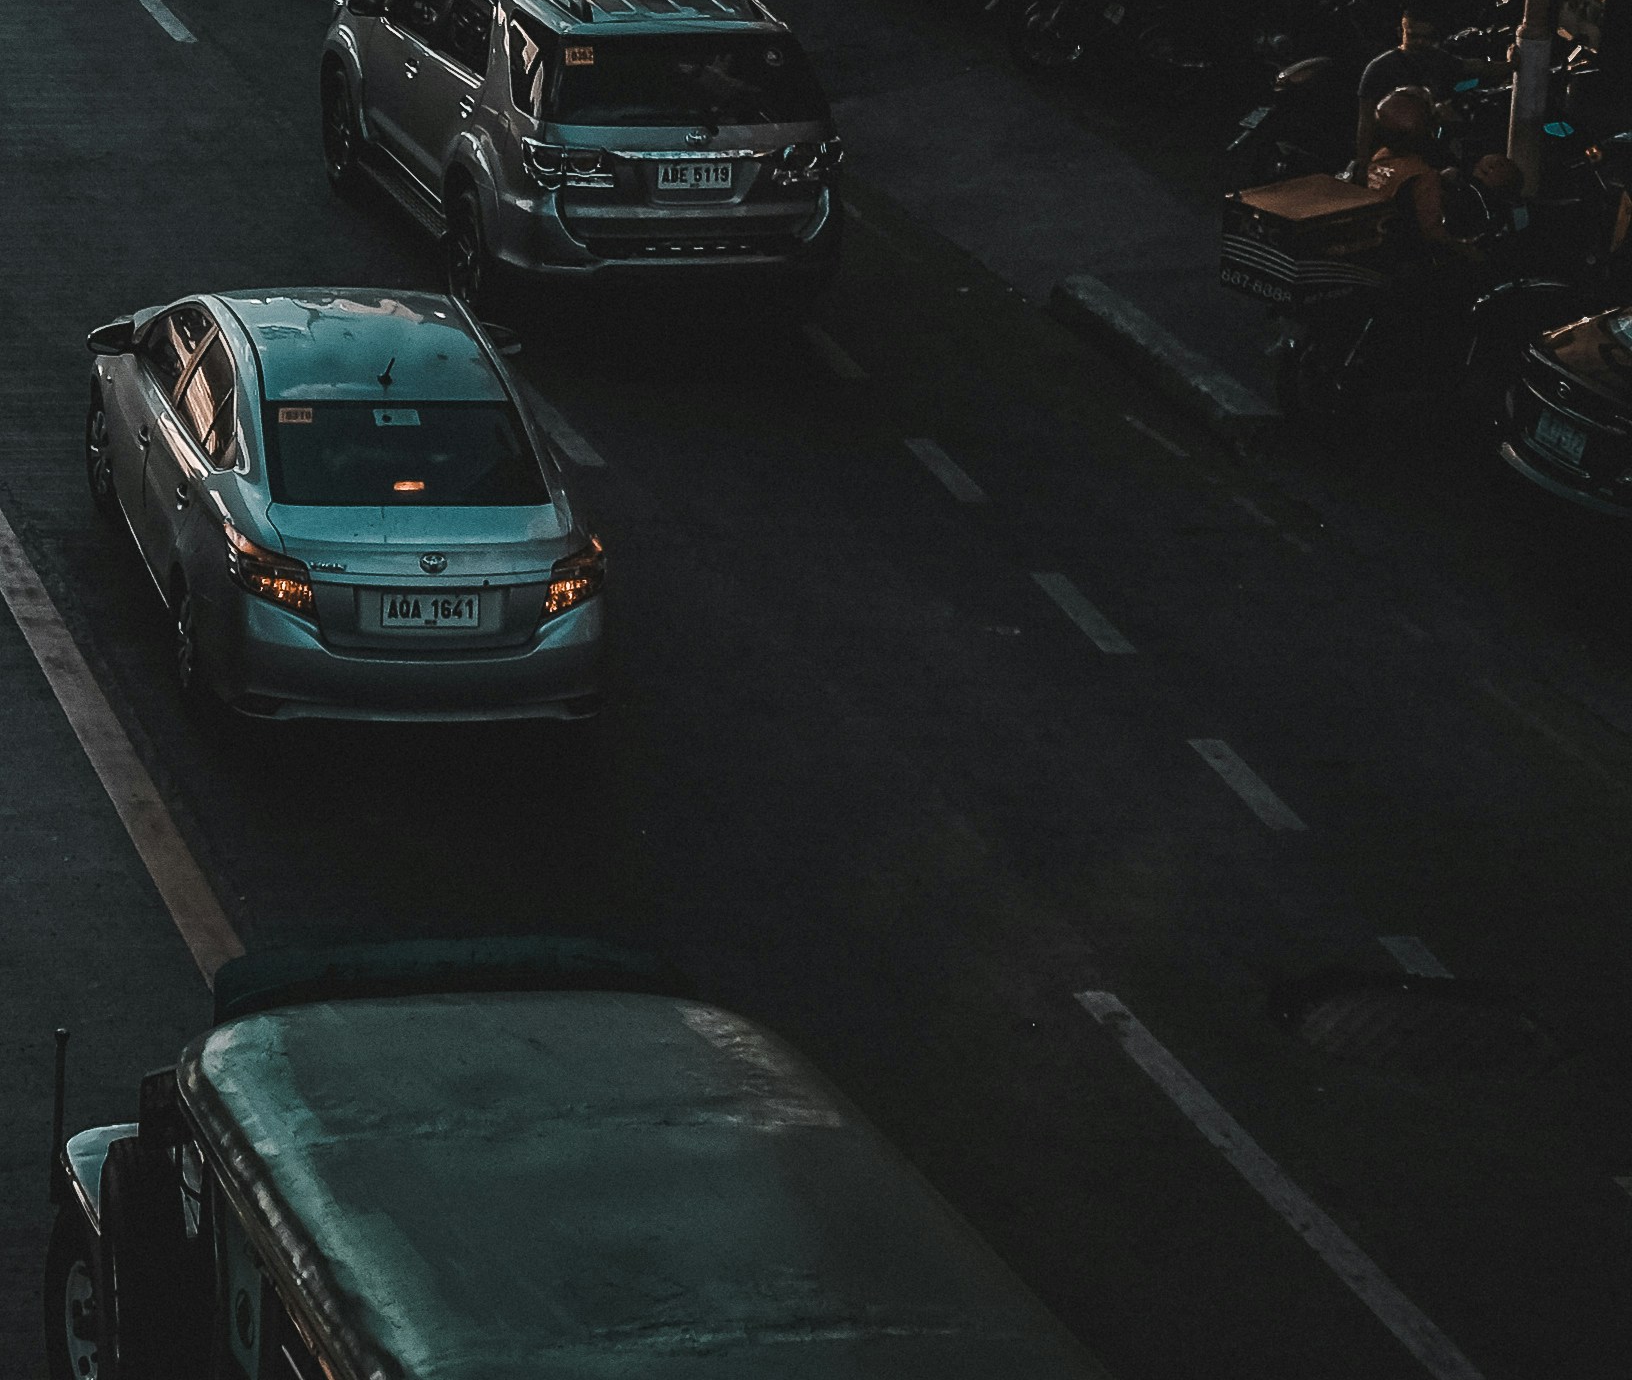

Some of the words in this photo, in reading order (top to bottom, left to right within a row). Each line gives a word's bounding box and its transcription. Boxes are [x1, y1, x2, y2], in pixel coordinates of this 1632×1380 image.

[660, 168, 688, 183] ABE
[693, 167, 730, 183] 5119
[387, 601, 421, 619] AQA
[432, 600, 473, 619] 1641
